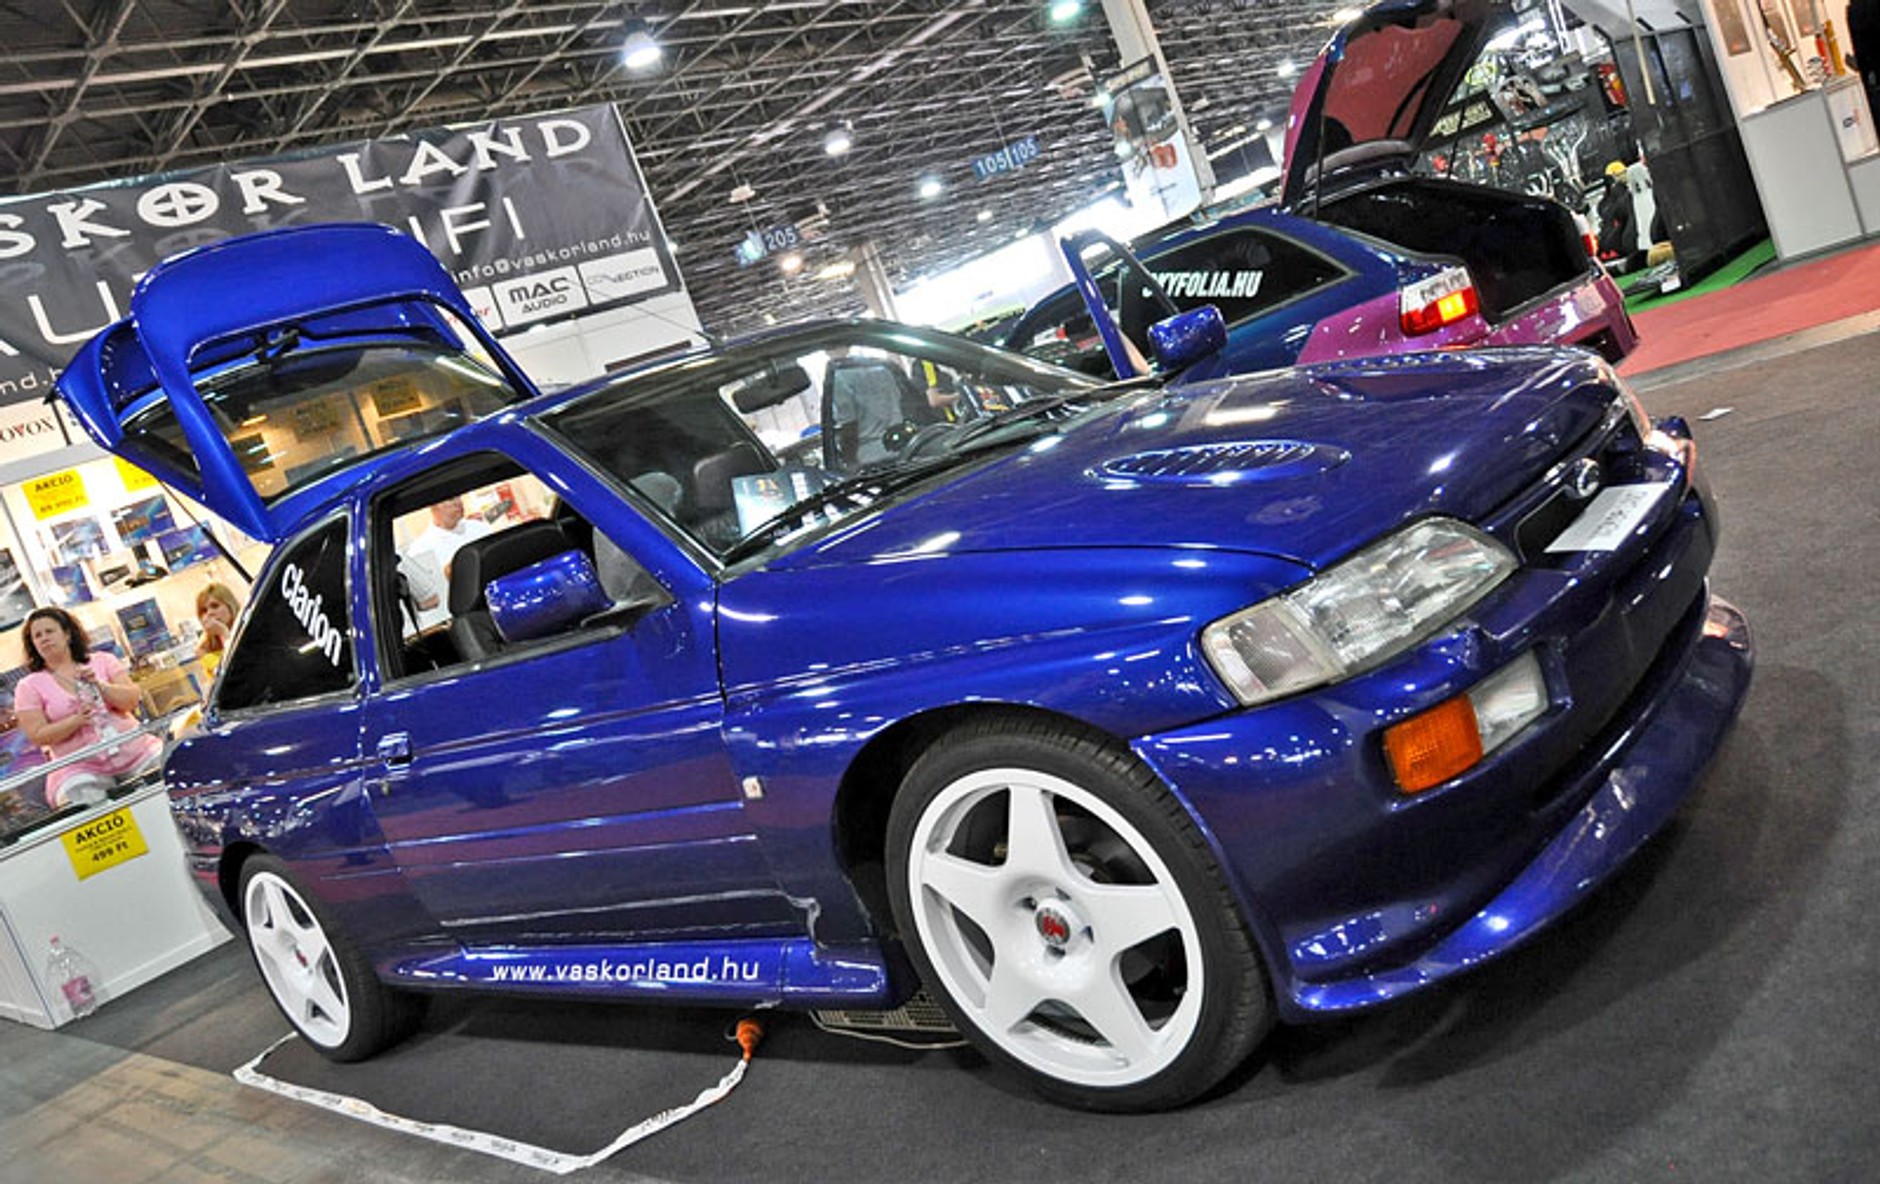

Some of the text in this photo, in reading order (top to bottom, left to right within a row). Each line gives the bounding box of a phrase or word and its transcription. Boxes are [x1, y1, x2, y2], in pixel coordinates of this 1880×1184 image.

[336, 119, 591, 195] LAND
[976, 138, 1037, 176] 105 105
[408, 197, 525, 256] IFI
[765, 226, 798, 250] 205
[508, 276, 571, 305] MAC
[1142, 270, 1263, 297] YFOLIA.HU
[521, 294, 568, 314] AUDIO
[492, 956, 759, 981] www.vaskorland.hu
